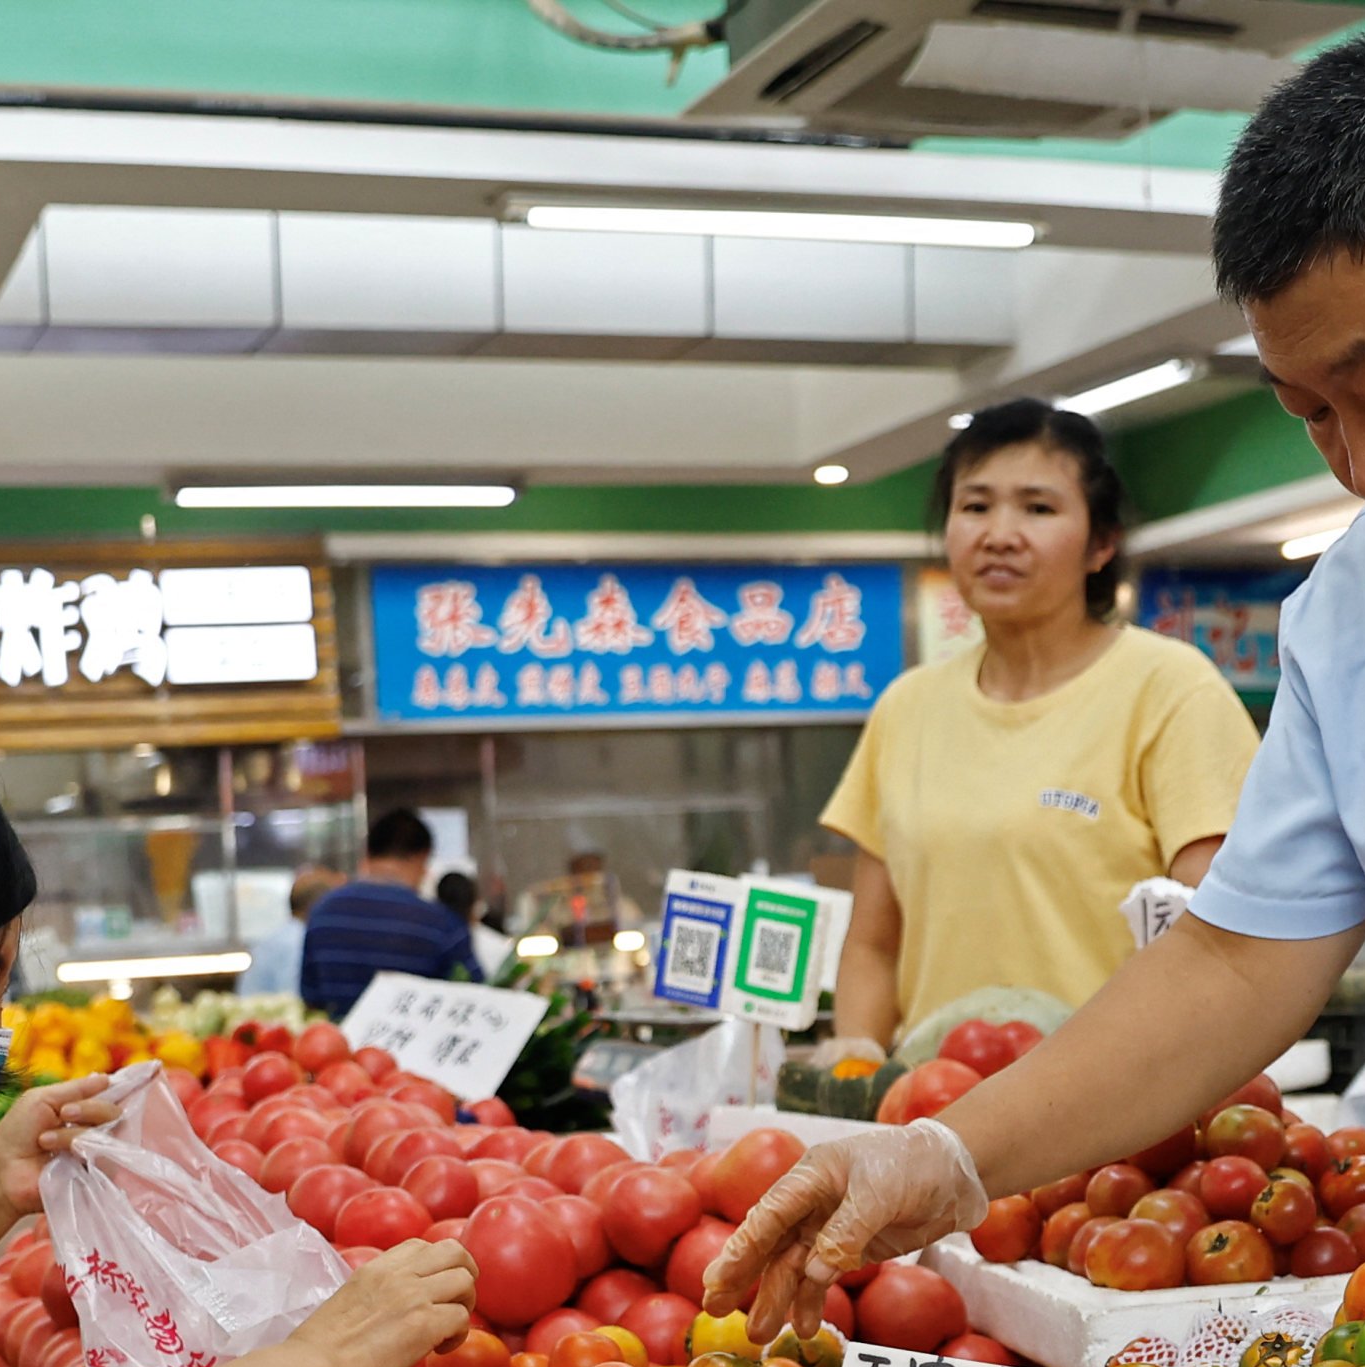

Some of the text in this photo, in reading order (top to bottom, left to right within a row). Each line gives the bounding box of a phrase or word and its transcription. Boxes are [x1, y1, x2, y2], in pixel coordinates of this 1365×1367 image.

[416, 572, 866, 659] 张先森食品店
